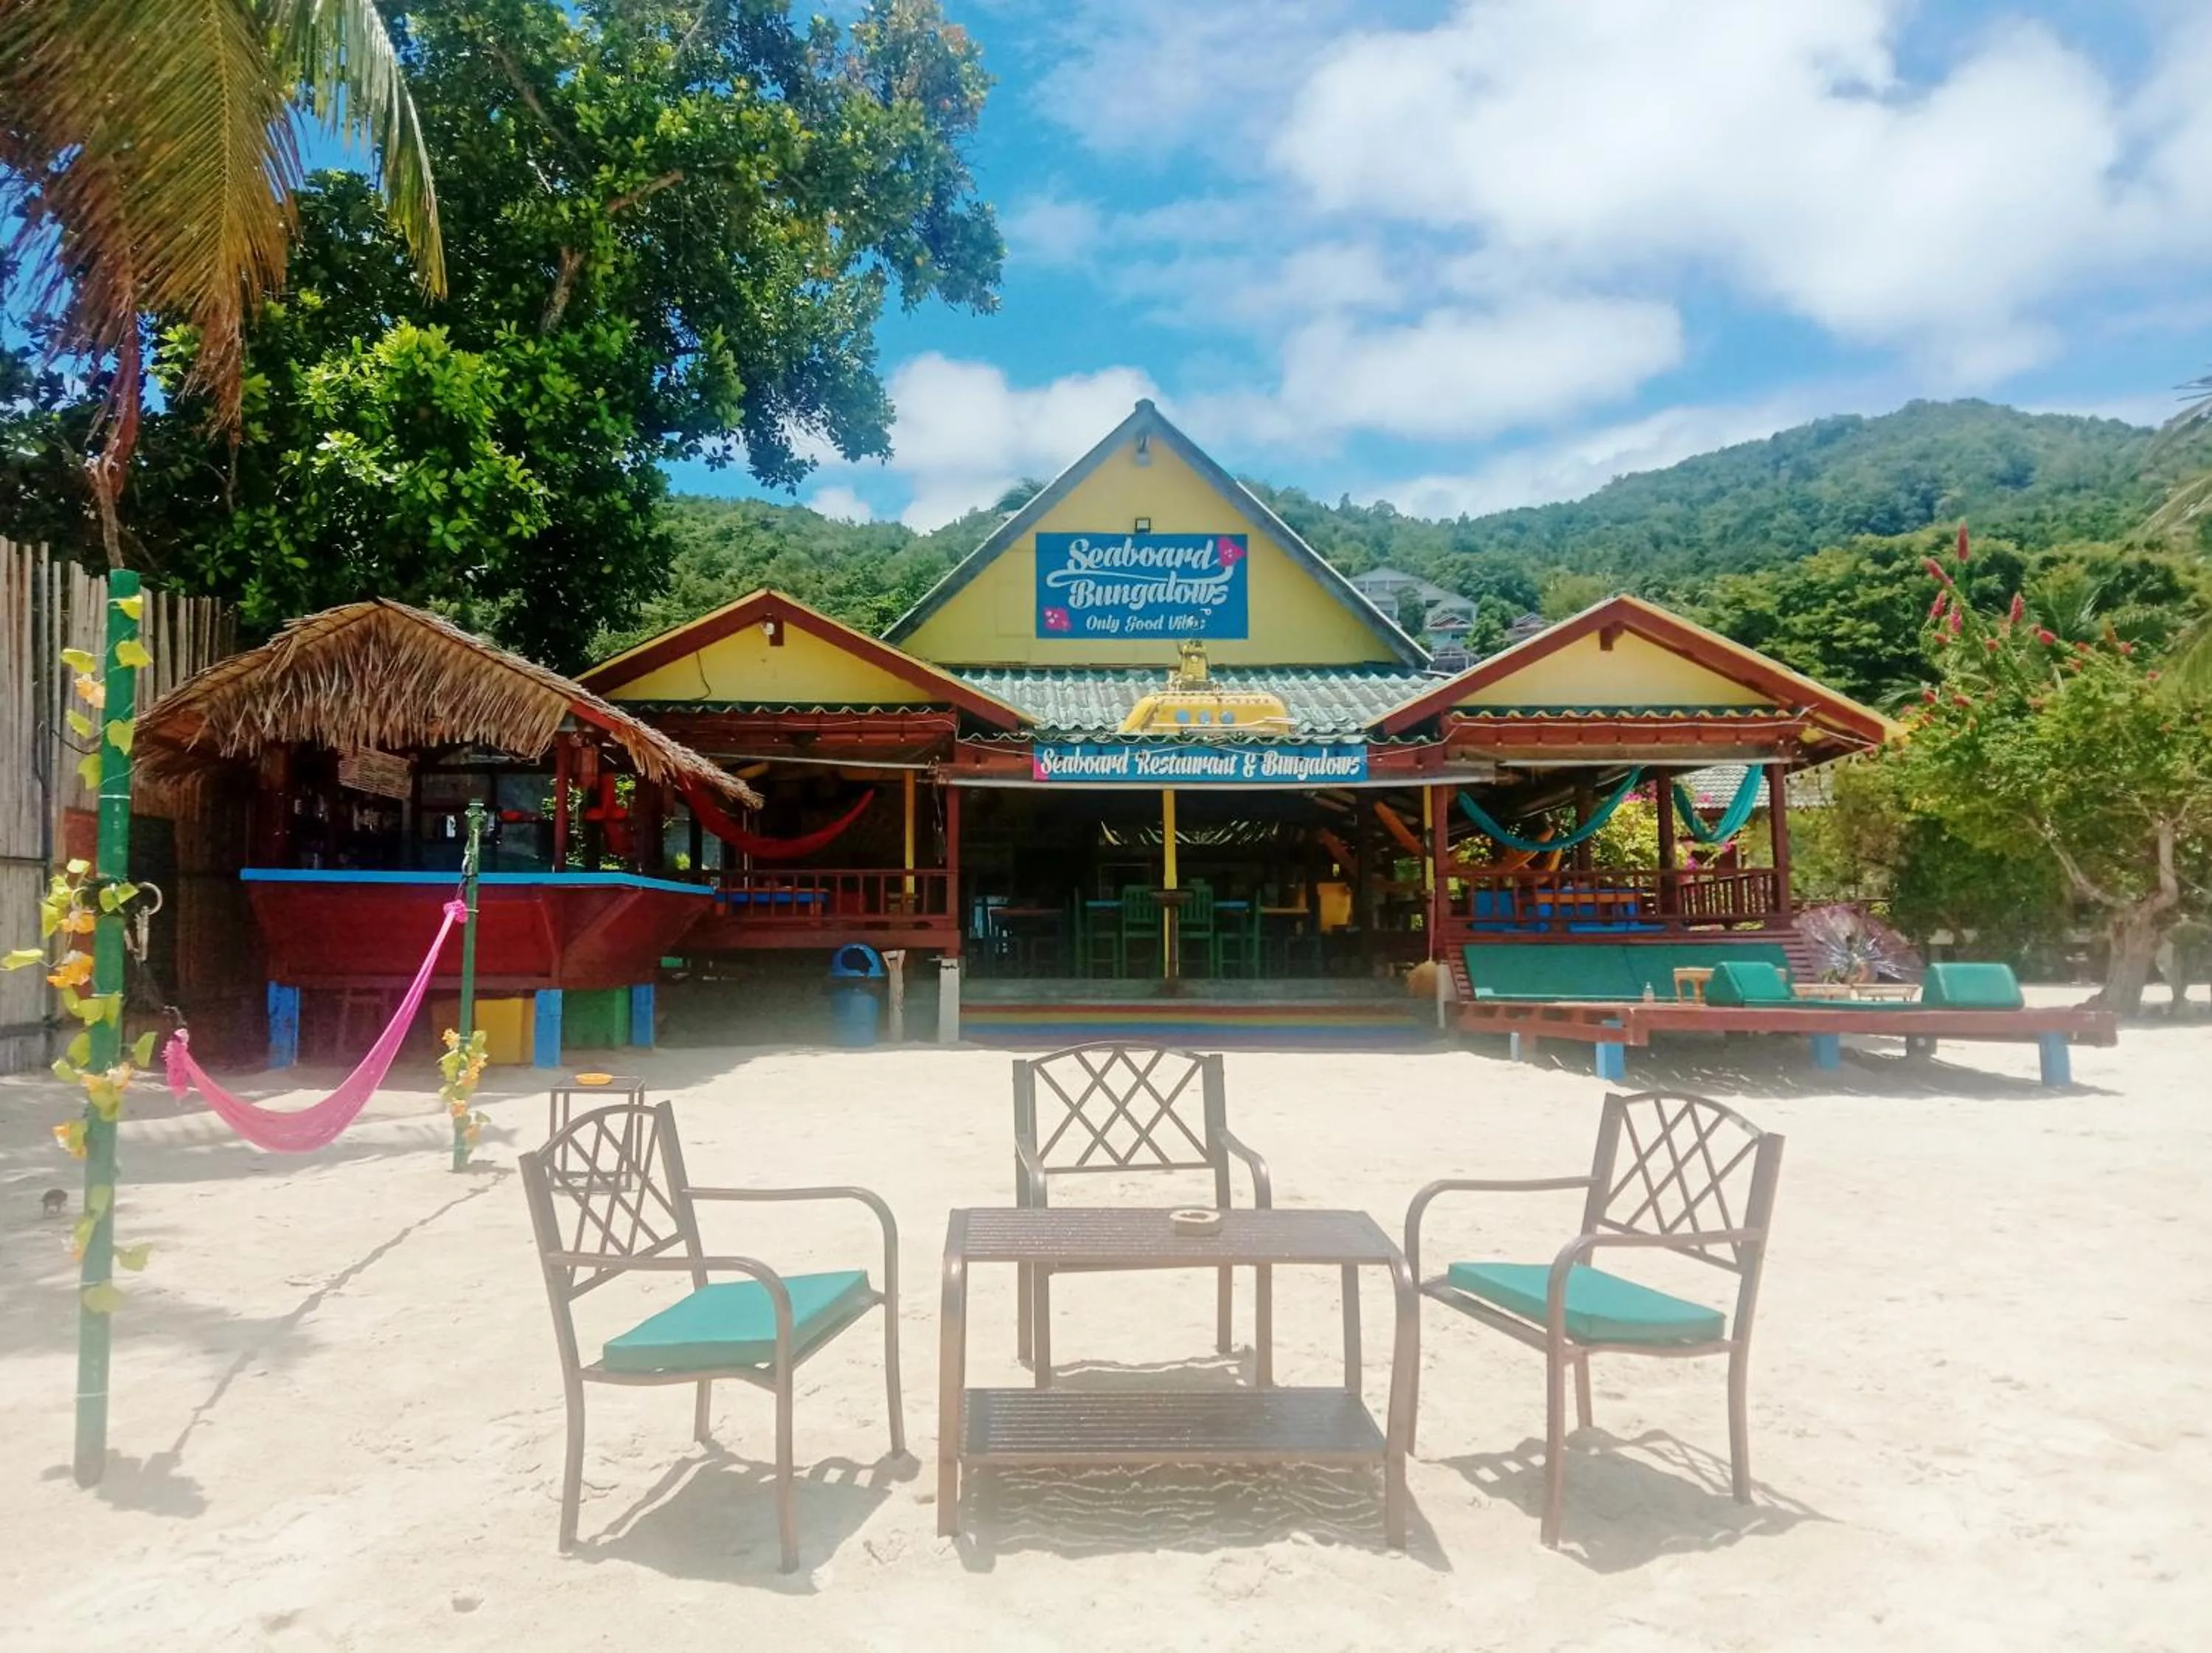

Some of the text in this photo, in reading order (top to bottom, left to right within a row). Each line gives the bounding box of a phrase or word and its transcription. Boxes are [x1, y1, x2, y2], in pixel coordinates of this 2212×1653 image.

[1066, 537, 1217, 571] Seaboard
[1068, 571, 1229, 610] Bungalows
[1085, 614, 1120, 633] Only
[1124, 614, 1164, 633] Good
[1040, 746, 1360, 781] Seaboard Restaurant & Bungalows
